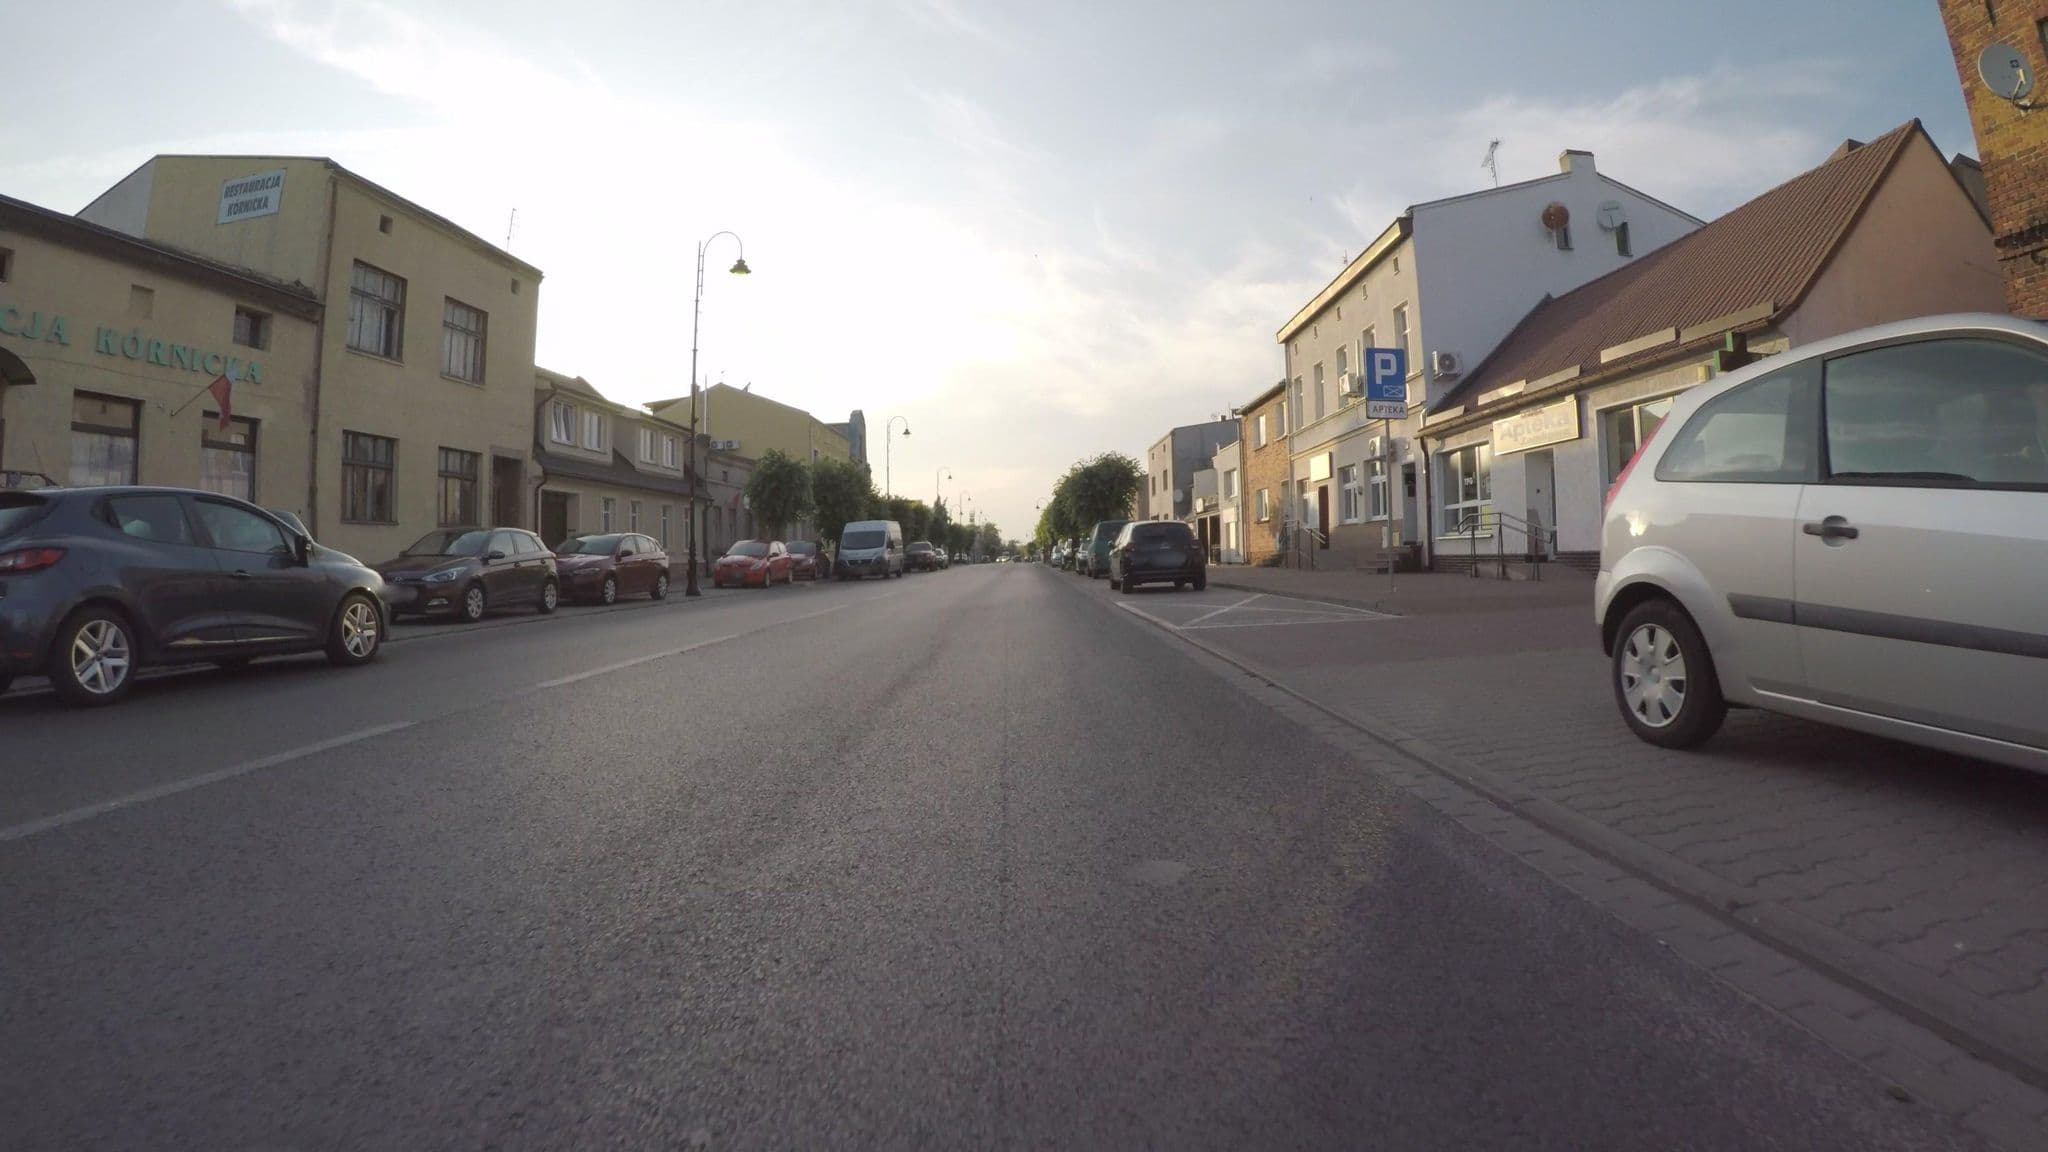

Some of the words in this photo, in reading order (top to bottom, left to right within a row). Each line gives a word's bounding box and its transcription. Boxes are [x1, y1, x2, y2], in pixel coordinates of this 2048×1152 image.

[224, 176, 281, 199] RESTAURACJA
[1375, 353, 1397, 384] P
[1373, 405, 1404, 414] APTEKA
